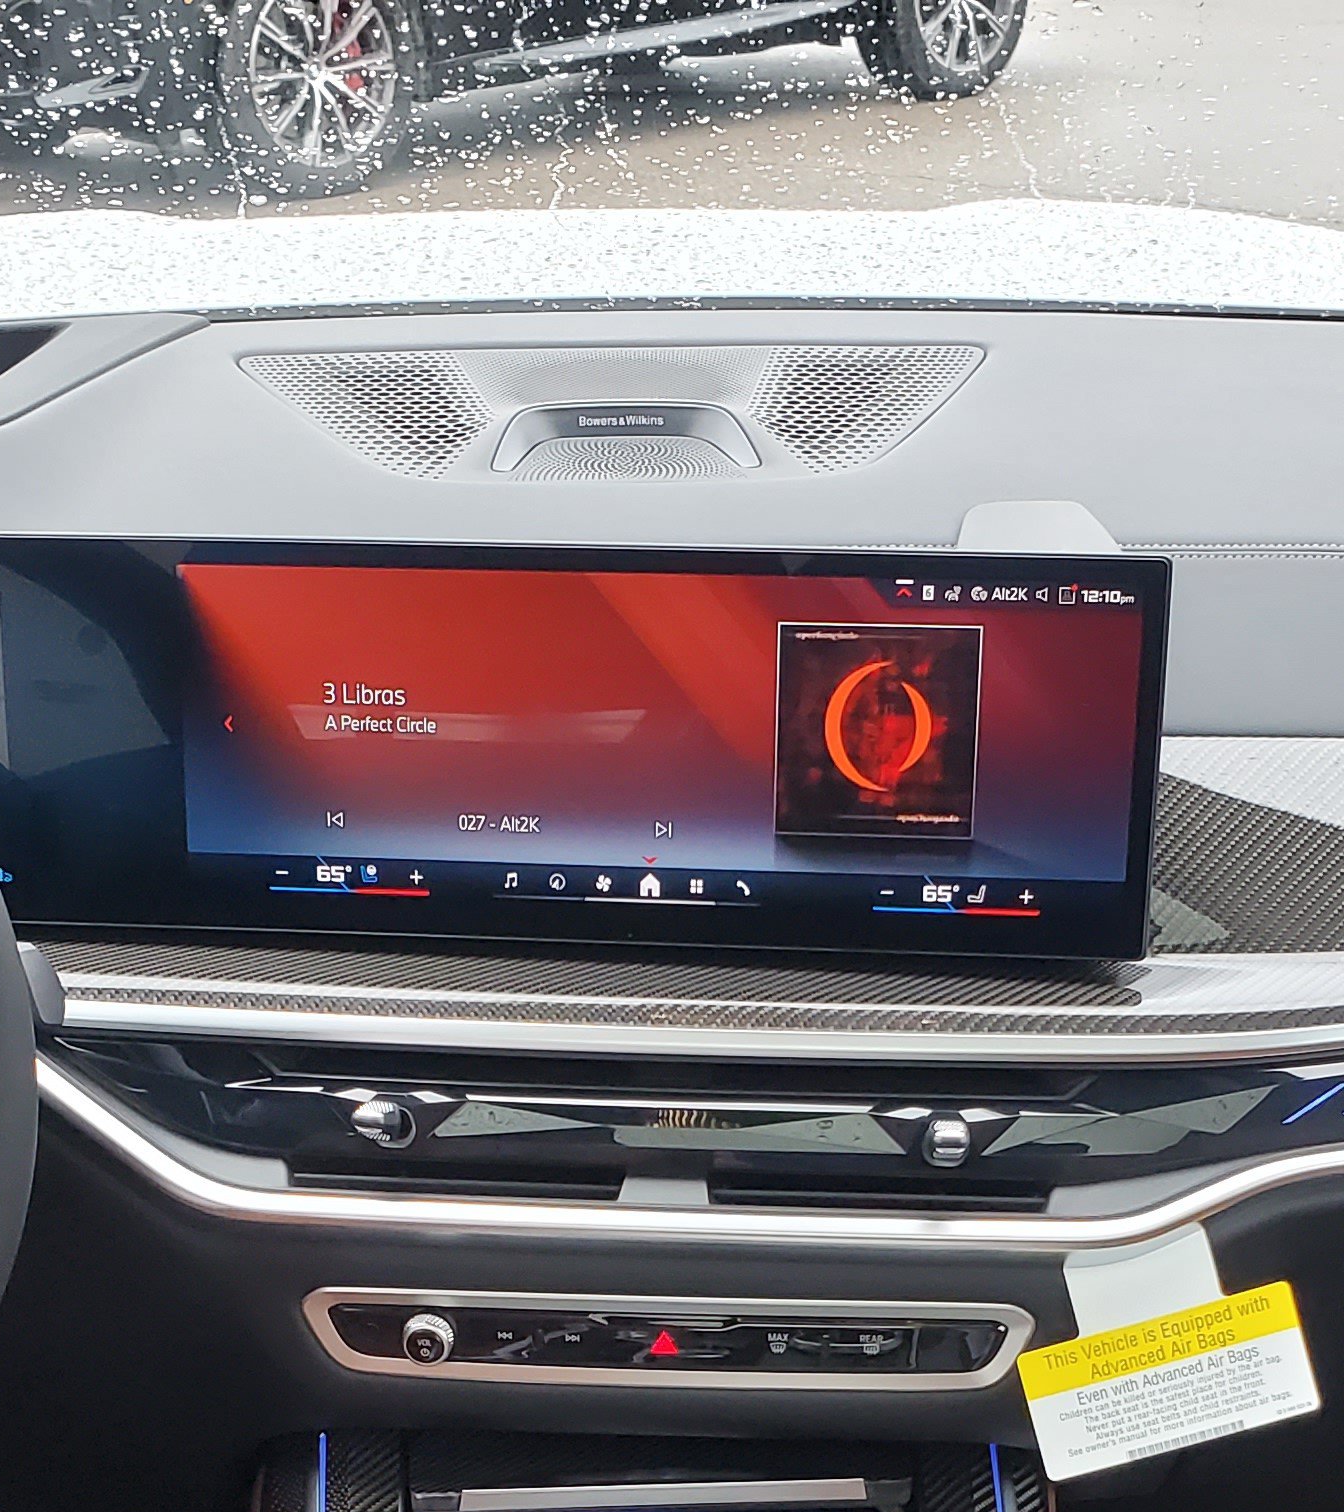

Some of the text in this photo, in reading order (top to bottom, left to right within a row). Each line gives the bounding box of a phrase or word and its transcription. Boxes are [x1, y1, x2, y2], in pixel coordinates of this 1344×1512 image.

[991, 587, 1028, 601] Alt2K
[322, 682, 406, 706] 3 Libras
[324, 715, 437, 734] A Perfect Circle
[458, 814, 485, 832] 027
[499, 816, 541, 833] Alt2K
[767, 1333, 789, 1342] MAX
[859, 1334, 884, 1343] REAR
[1043, 1296, 1270, 1370] This Vehicle is Equipped with
[1092, 1330, 1238, 1380] Advanced Air Bags
[1060, 1408, 1093, 1422] Children
[1095, 1404, 1109, 1412] can
[1111, 1400, 1122, 1408] be
[1123, 1392, 1145, 1404] killed
[1158, 1380, 1194, 1395] seriously
[1197, 1370, 1224, 1384] injured
[1226, 1369, 1235, 1377] by
[1238, 1362, 1251, 1372] the
[1252, 1360, 1263, 1369] air
[1077, 1348, 1260, 1406] Even with Advanced Air Bags
[1084, 1416, 1099, 1424] The
[1101, 1410, 1120, 1420] back
[1122, 1404, 1139, 1415] seat
[1151, 1399, 1164, 1407] the
[1166, 1390, 1189, 1403] safest
[1191, 1383, 1214, 1397] place
[1215, 1381, 1226, 1389] for
[1086, 1423, 1108, 1433] Never
[1111, 1418, 1125, 1428] put
[1134, 1404, 1177, 1421] rear-facing
[1180, 1396, 1199, 1408] child
[1201, 1392, 1218, 1402] seat
[1229, 1386, 1242, 1394] the
[1096, 1428, 1124, 1441] Always
[1126, 1424, 1140, 1433] use
[1143, 1418, 1159, 1428] seat
[1161, 1413, 1181, 1423] belts
[1183, 1407, 1197, 1417] and
[1200, 1401, 1219, 1412] child
[1068, 1449, 1083, 1458] See
[1085, 1439, 1116, 1453] owner's
[1117, 1430, 1147, 1444] manual
[1150, 1428, 1161, 1436] for
[1164, 1422, 1184, 1432] more
[1187, 1408, 1232, 1425] information
[1235, 1400, 1257, 1412] about
[1259, 1397, 1269, 1406] air
